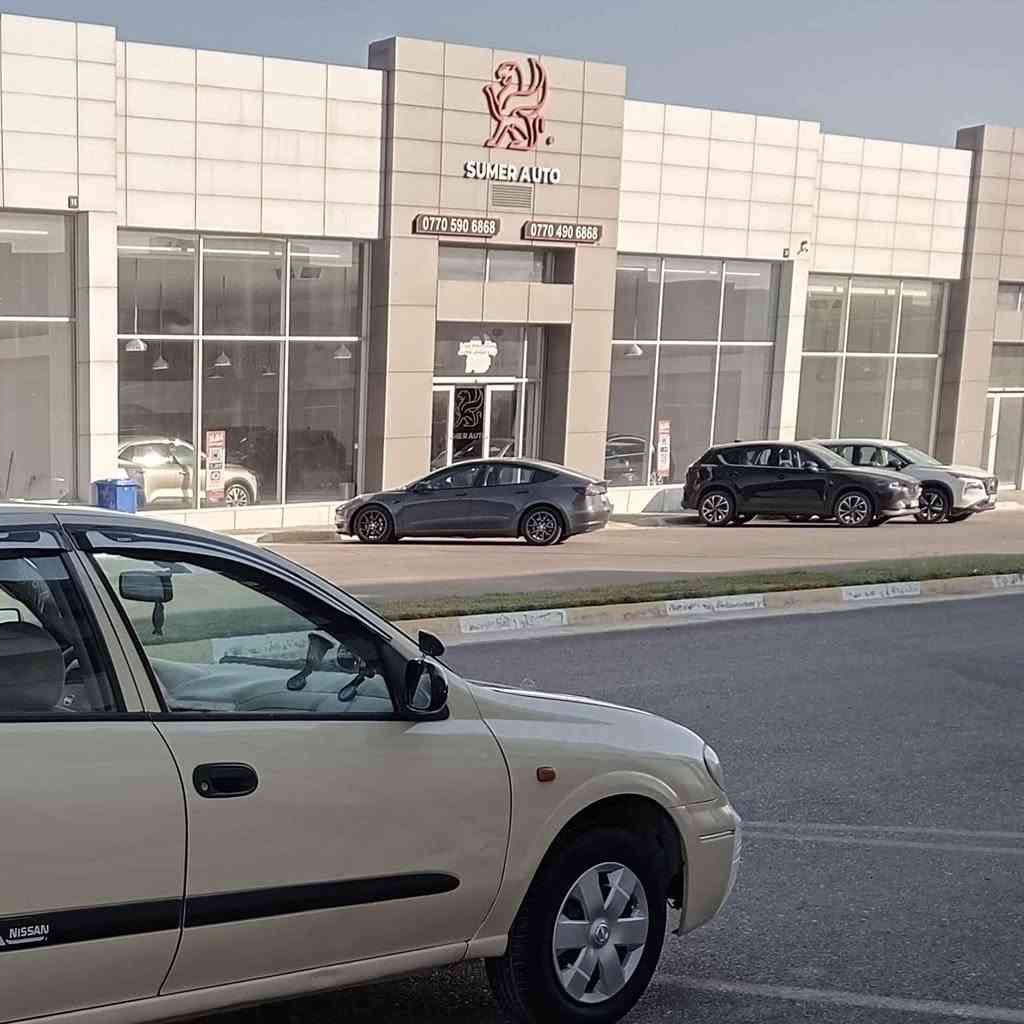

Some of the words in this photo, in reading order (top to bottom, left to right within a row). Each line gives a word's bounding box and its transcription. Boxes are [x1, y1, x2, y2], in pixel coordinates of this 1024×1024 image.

[464, 160, 517, 182] SUMER
[519, 166, 560, 184] AUTO
[422, 216, 448, 231] 0770
[450, 218, 469, 233] 590
[471, 219, 496, 234] 6868
[530, 223, 554, 237] 0770
[555, 224, 573, 239] 490
[575, 225, 599, 240] 6868
[9, 924, 50, 939] NISSAN
